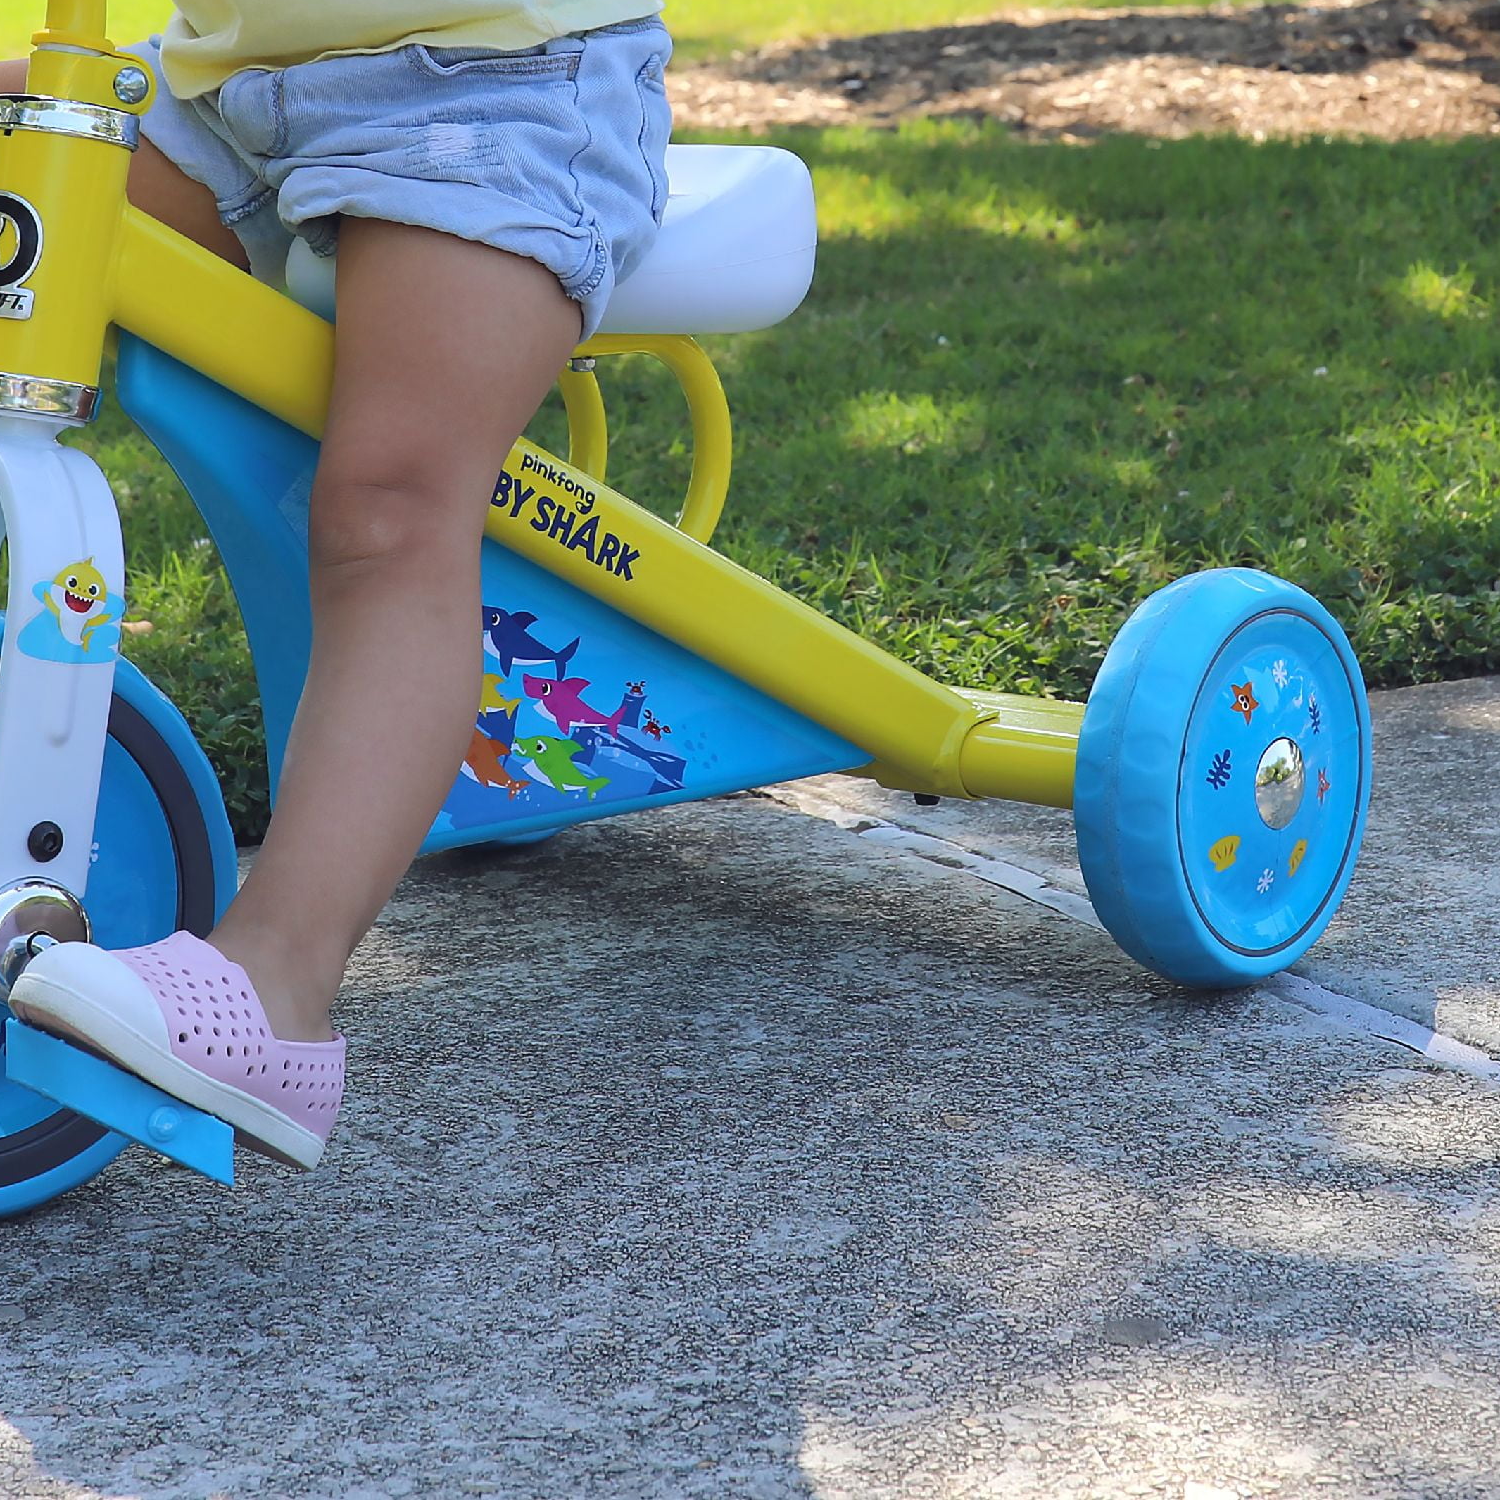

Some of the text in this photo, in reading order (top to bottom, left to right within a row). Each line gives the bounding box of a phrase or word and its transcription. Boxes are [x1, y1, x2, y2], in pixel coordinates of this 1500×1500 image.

[490, 469, 641, 582] BY SHARK
[520, 453, 596, 515] pinkfong
